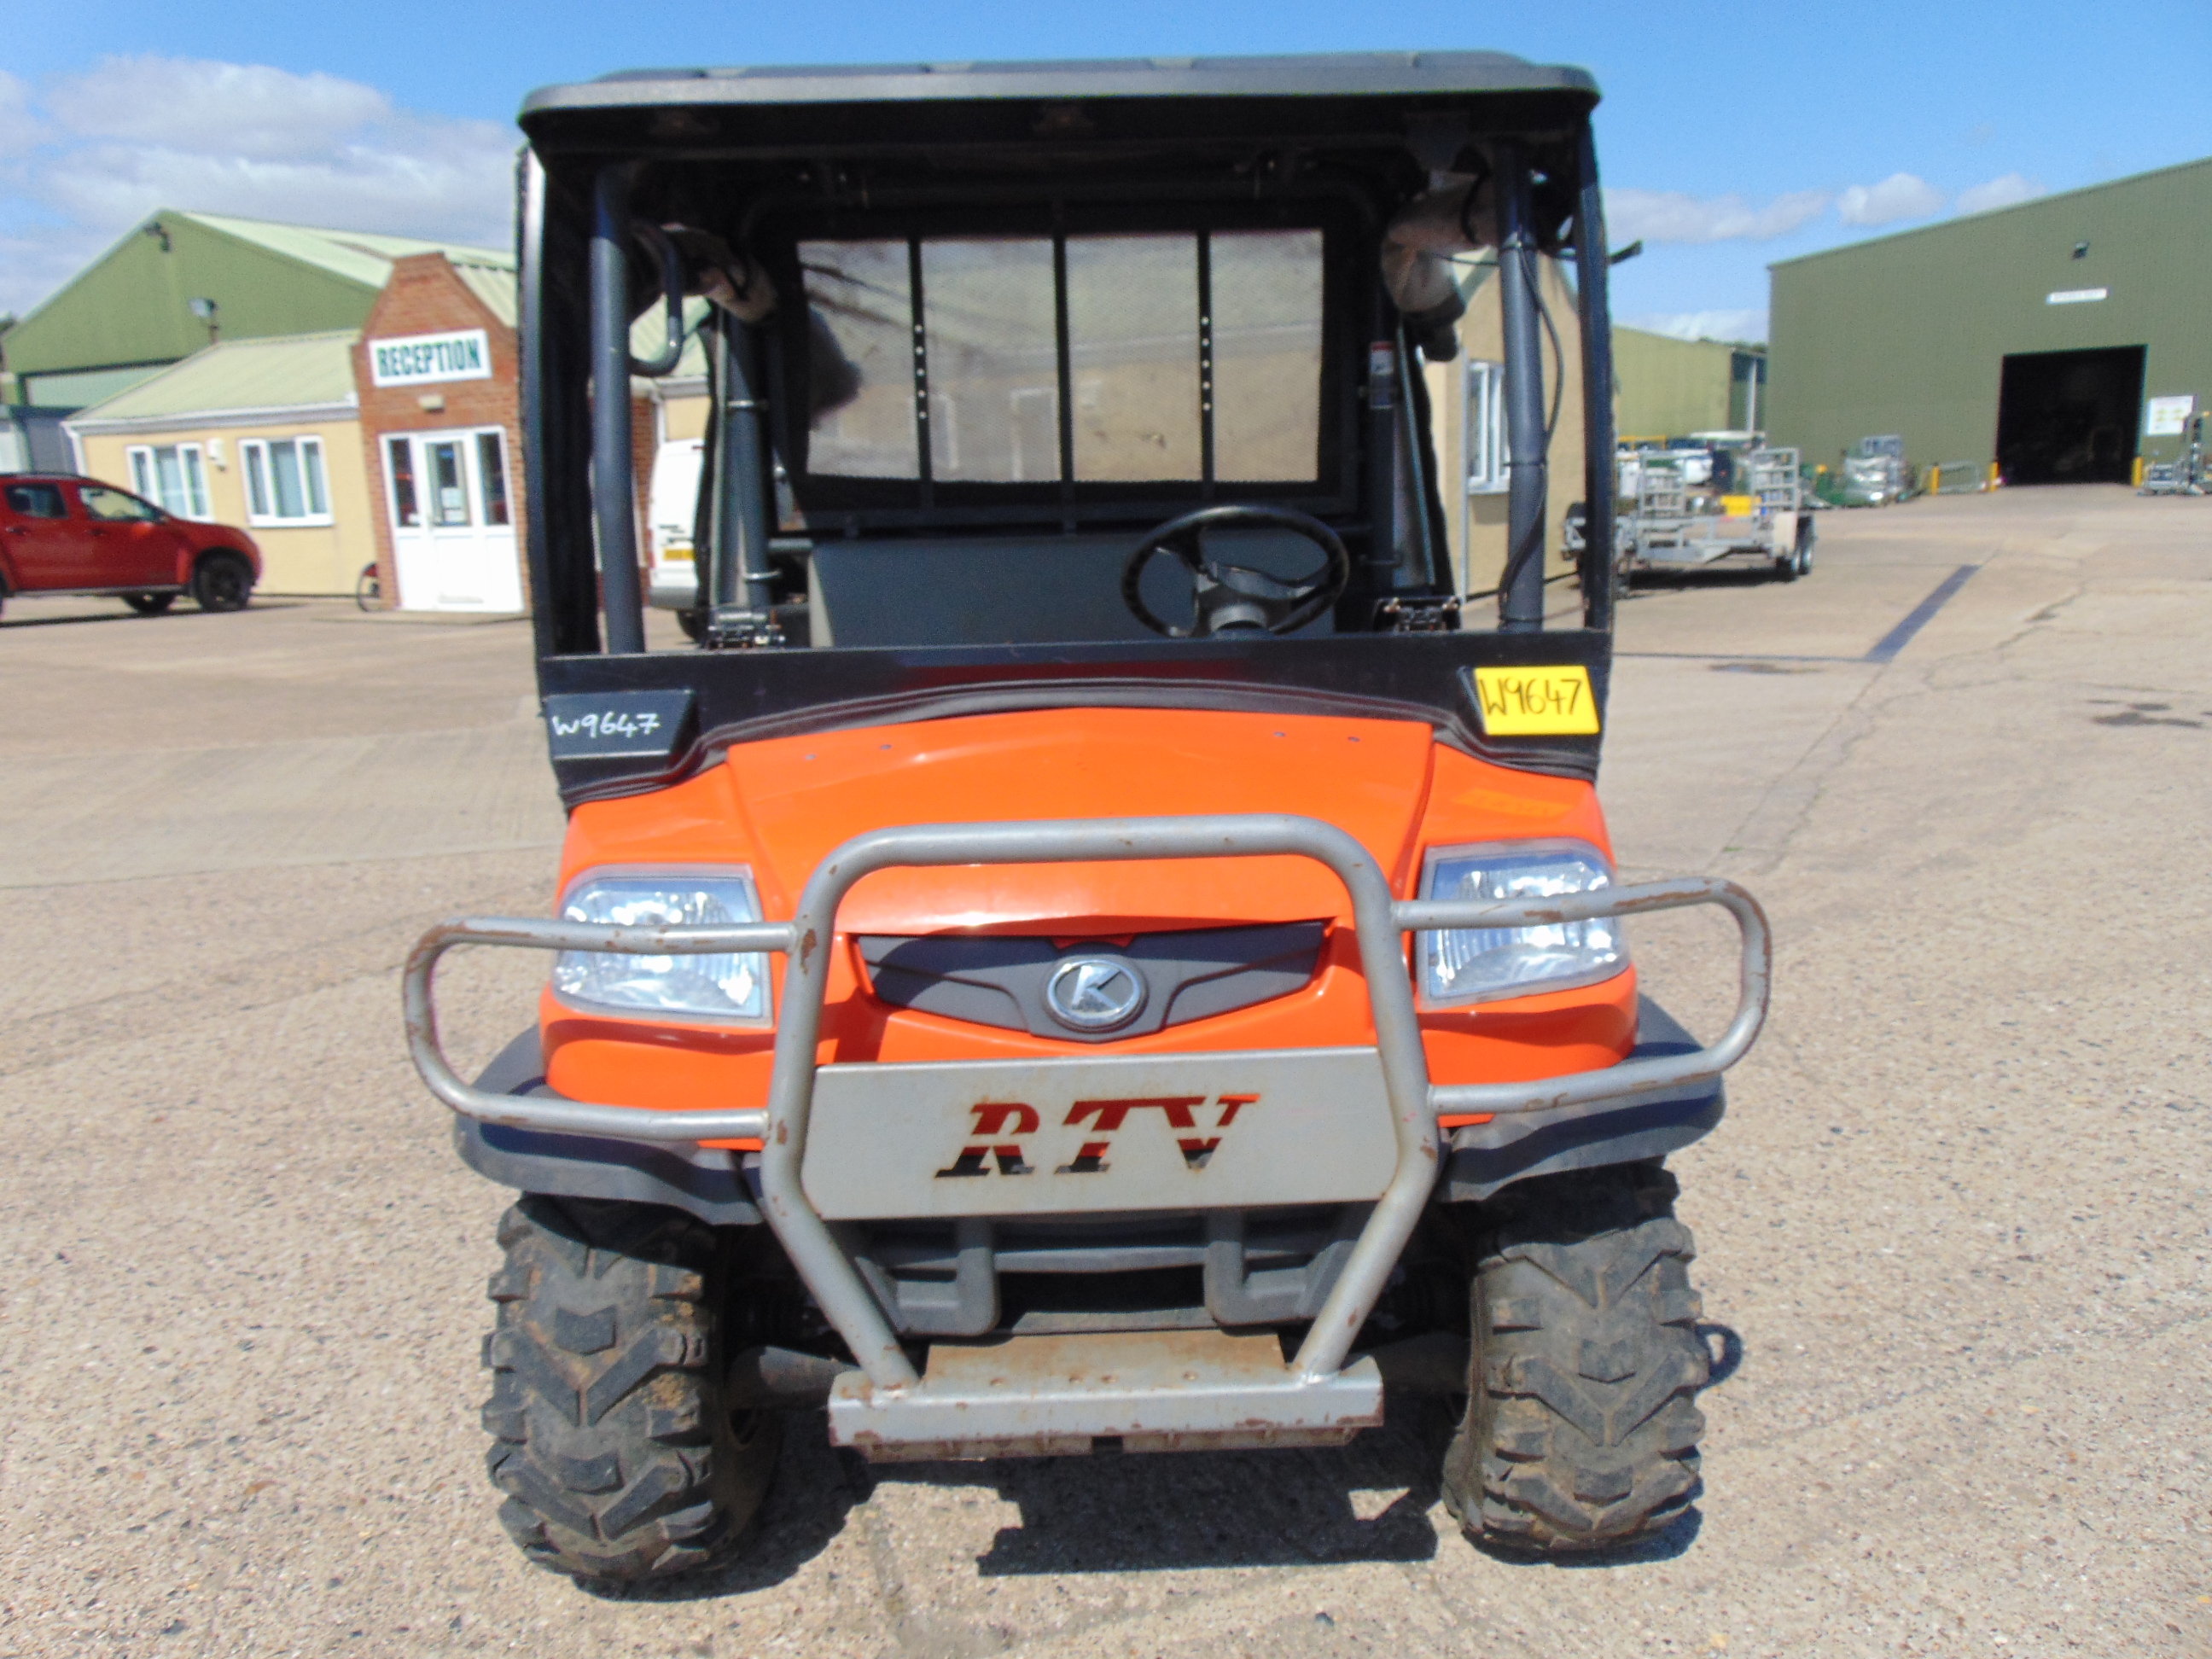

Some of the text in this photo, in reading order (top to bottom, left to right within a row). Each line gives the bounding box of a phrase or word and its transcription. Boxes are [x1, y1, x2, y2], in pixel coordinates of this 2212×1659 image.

[376, 338, 480, 377] RECEPTION
[1479, 677, 1582, 716] W9647
[934, 1093, 1261, 1178] RTV
